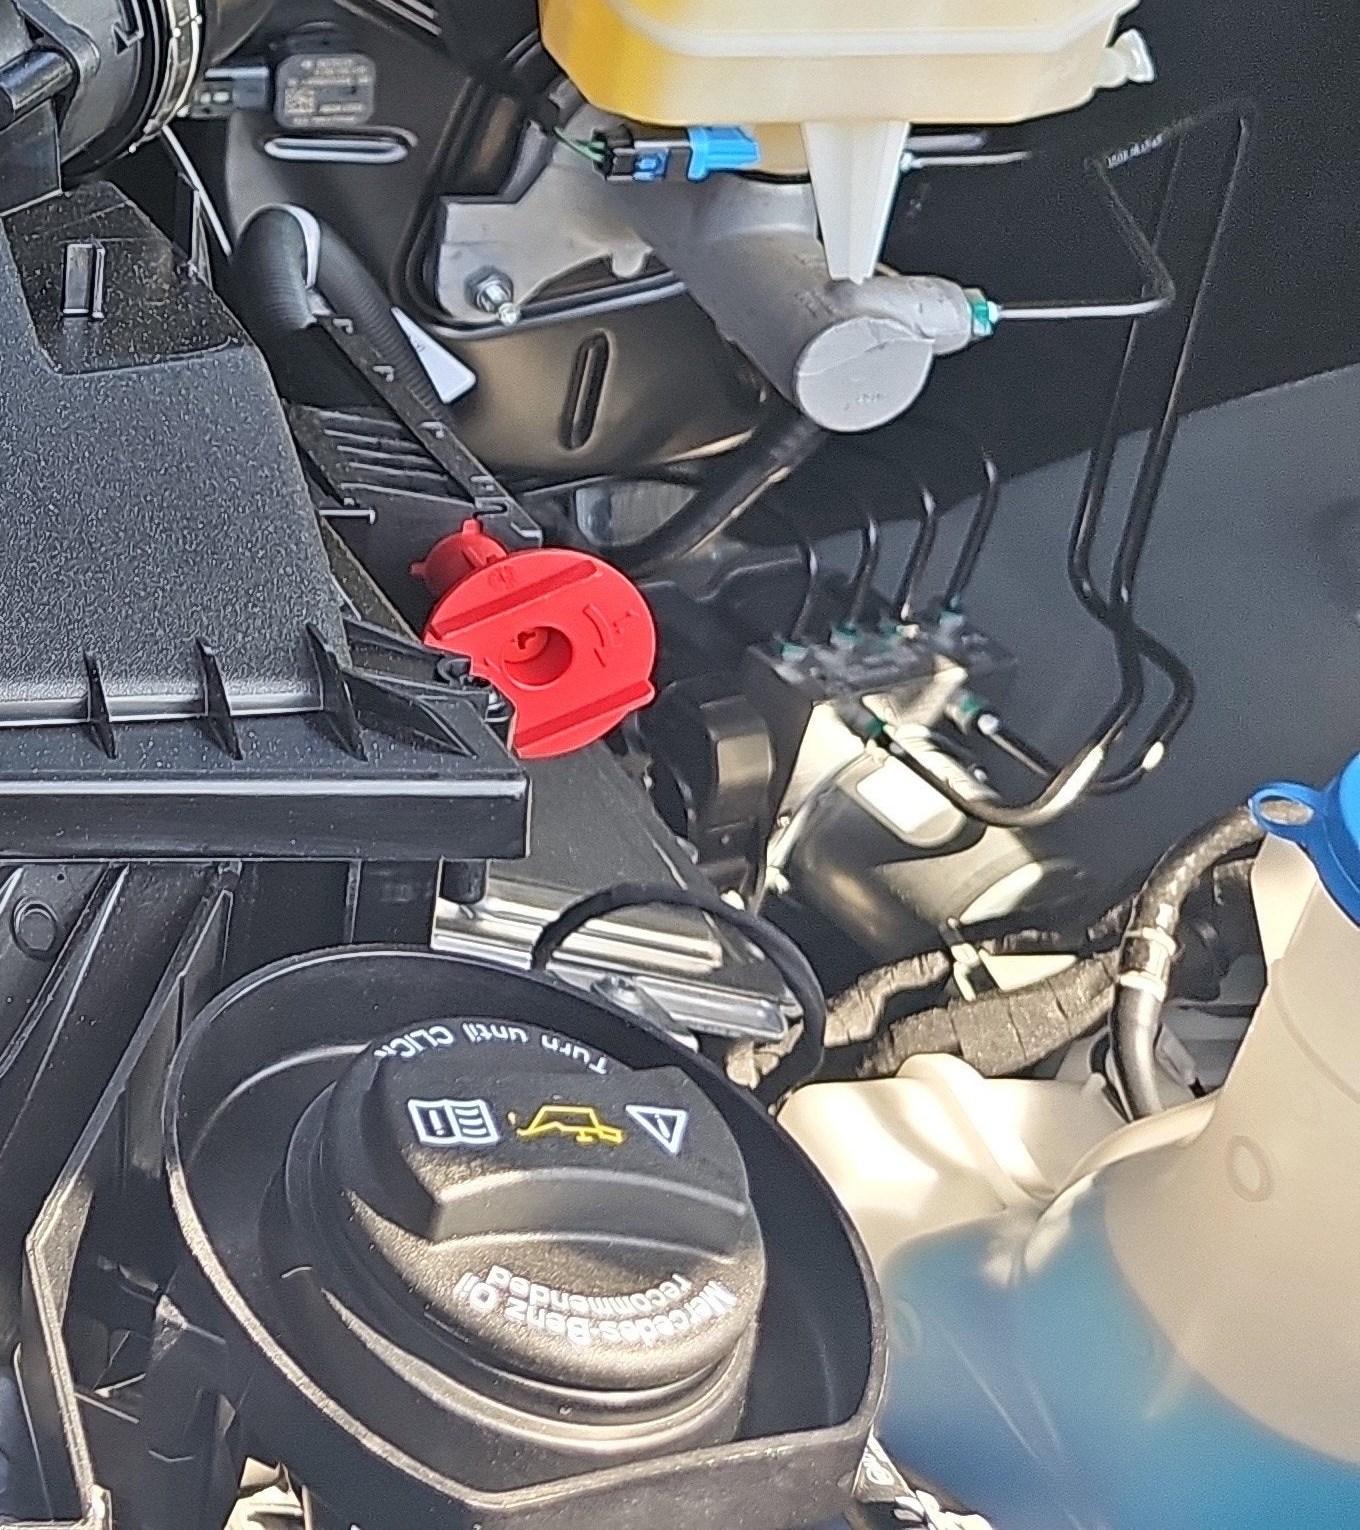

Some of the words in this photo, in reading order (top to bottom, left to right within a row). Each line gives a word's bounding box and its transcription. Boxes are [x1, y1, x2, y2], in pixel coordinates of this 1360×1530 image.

[461, 1022, 529, 1043] until
[540, 1033, 608, 1075] Turn
[452, 1272, 500, 1313] Oil
[485, 1264, 693, 1318] recommended
[503, 1280, 738, 1347] Mercedes-Benz
